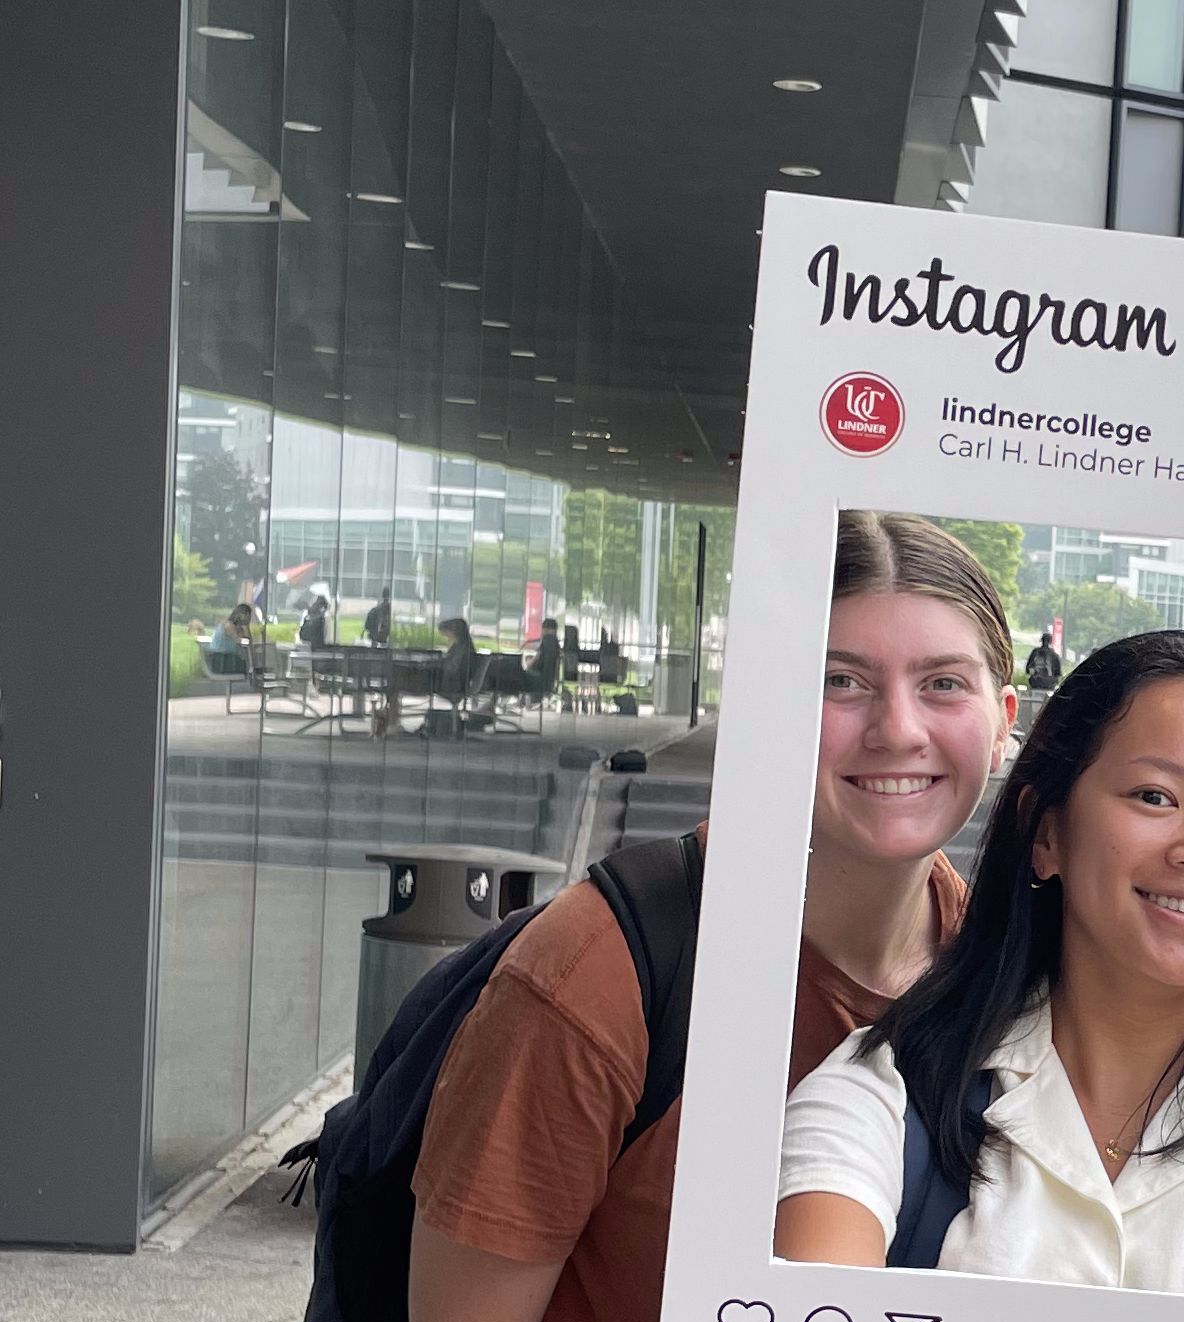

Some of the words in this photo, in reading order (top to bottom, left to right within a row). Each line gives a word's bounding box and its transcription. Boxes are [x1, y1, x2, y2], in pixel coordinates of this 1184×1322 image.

[807, 243, 1177, 375] Instagram
[837, 419, 887, 435] LINDNER
[941, 397, 1152, 447] lindnercollege
[938, 433, 993, 461] Carl
[1001, 439, 1028, 465] H.
[1038, 443, 1146, 477] Lindner
